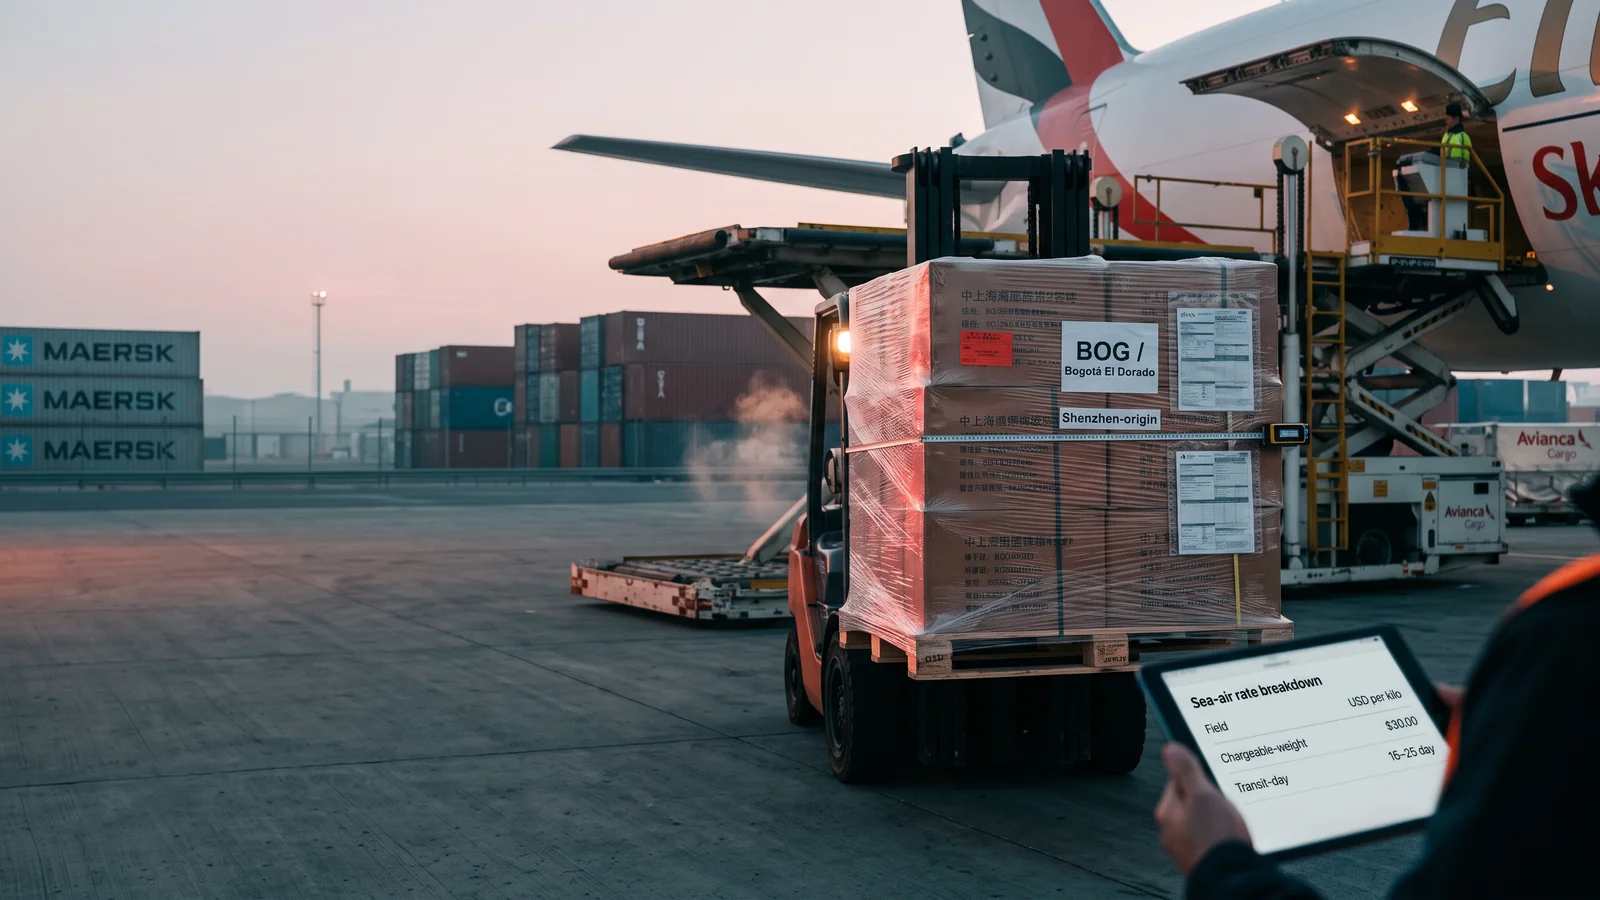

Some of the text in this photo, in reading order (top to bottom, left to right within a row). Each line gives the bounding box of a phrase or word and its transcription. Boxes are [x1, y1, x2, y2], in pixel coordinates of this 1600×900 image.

[44, 341, 175, 363] MAERSK
[1077, 340, 1145, 362] BOG /
[1065, 365, 1156, 379] Bogotá El Dorado
[44, 390, 175, 411] MAERSK
[1062, 412, 1157, 428] Shenzhen-origin
[1517, 430, 1576, 446] Avianca
[44, 439, 176, 461] MAERSK
[1547, 448, 1577, 462] Cargo
[1445, 505, 1485, 518] Avianca
[1465, 519, 1485, 531] Cargo
[1190, 674, 1323, 709] Sea-air rate breakdown
[1347, 688, 1402, 708] USD per kilo
[1204, 720, 1229, 735] Field
[1385, 715, 1419, 732] $30.00
[1220, 739, 1308, 764] Chargeable-weight
[1418, 743, 1436, 758] day
[1235, 774, 1289, 793] Transit-day
